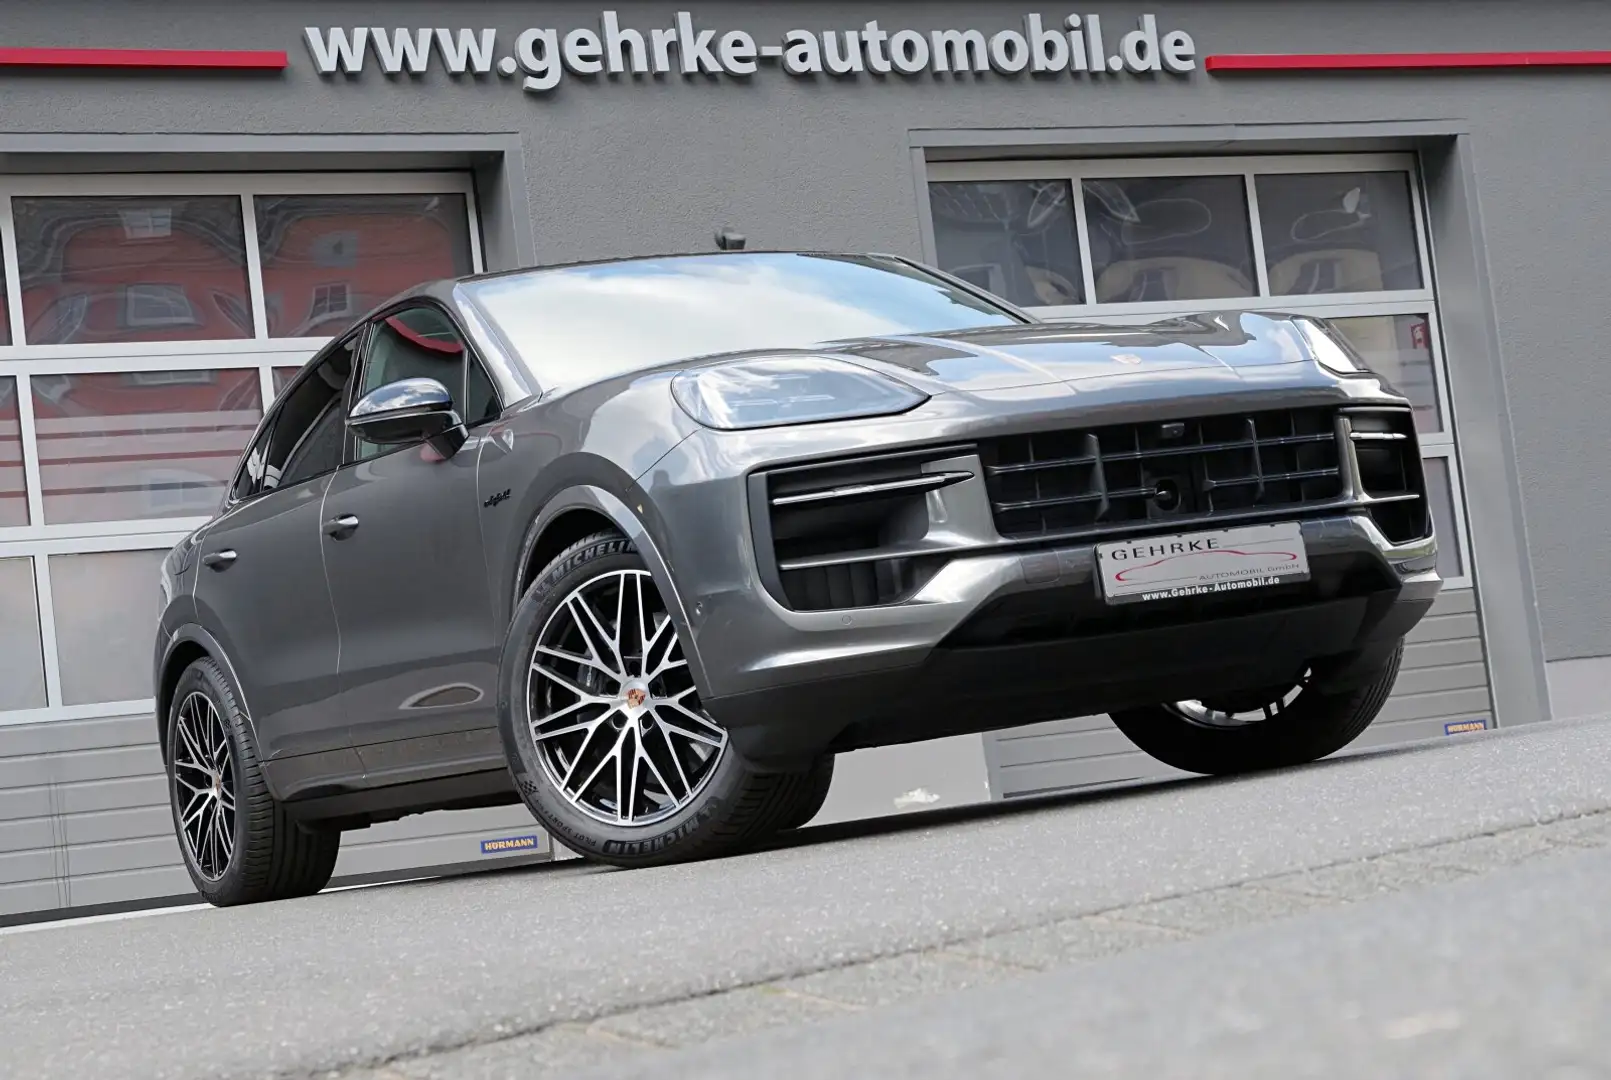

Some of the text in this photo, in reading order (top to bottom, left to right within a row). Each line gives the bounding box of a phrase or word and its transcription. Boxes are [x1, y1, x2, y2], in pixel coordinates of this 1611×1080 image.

[303, 10, 1196, 92] www.gehrke-automobil.de
[1111, 538, 1220, 560] GEHRKE
[1199, 568, 1264, 580] AUTOMOBIL
[1142, 576, 1280, 601] www.Gehrke-Automobil.de
